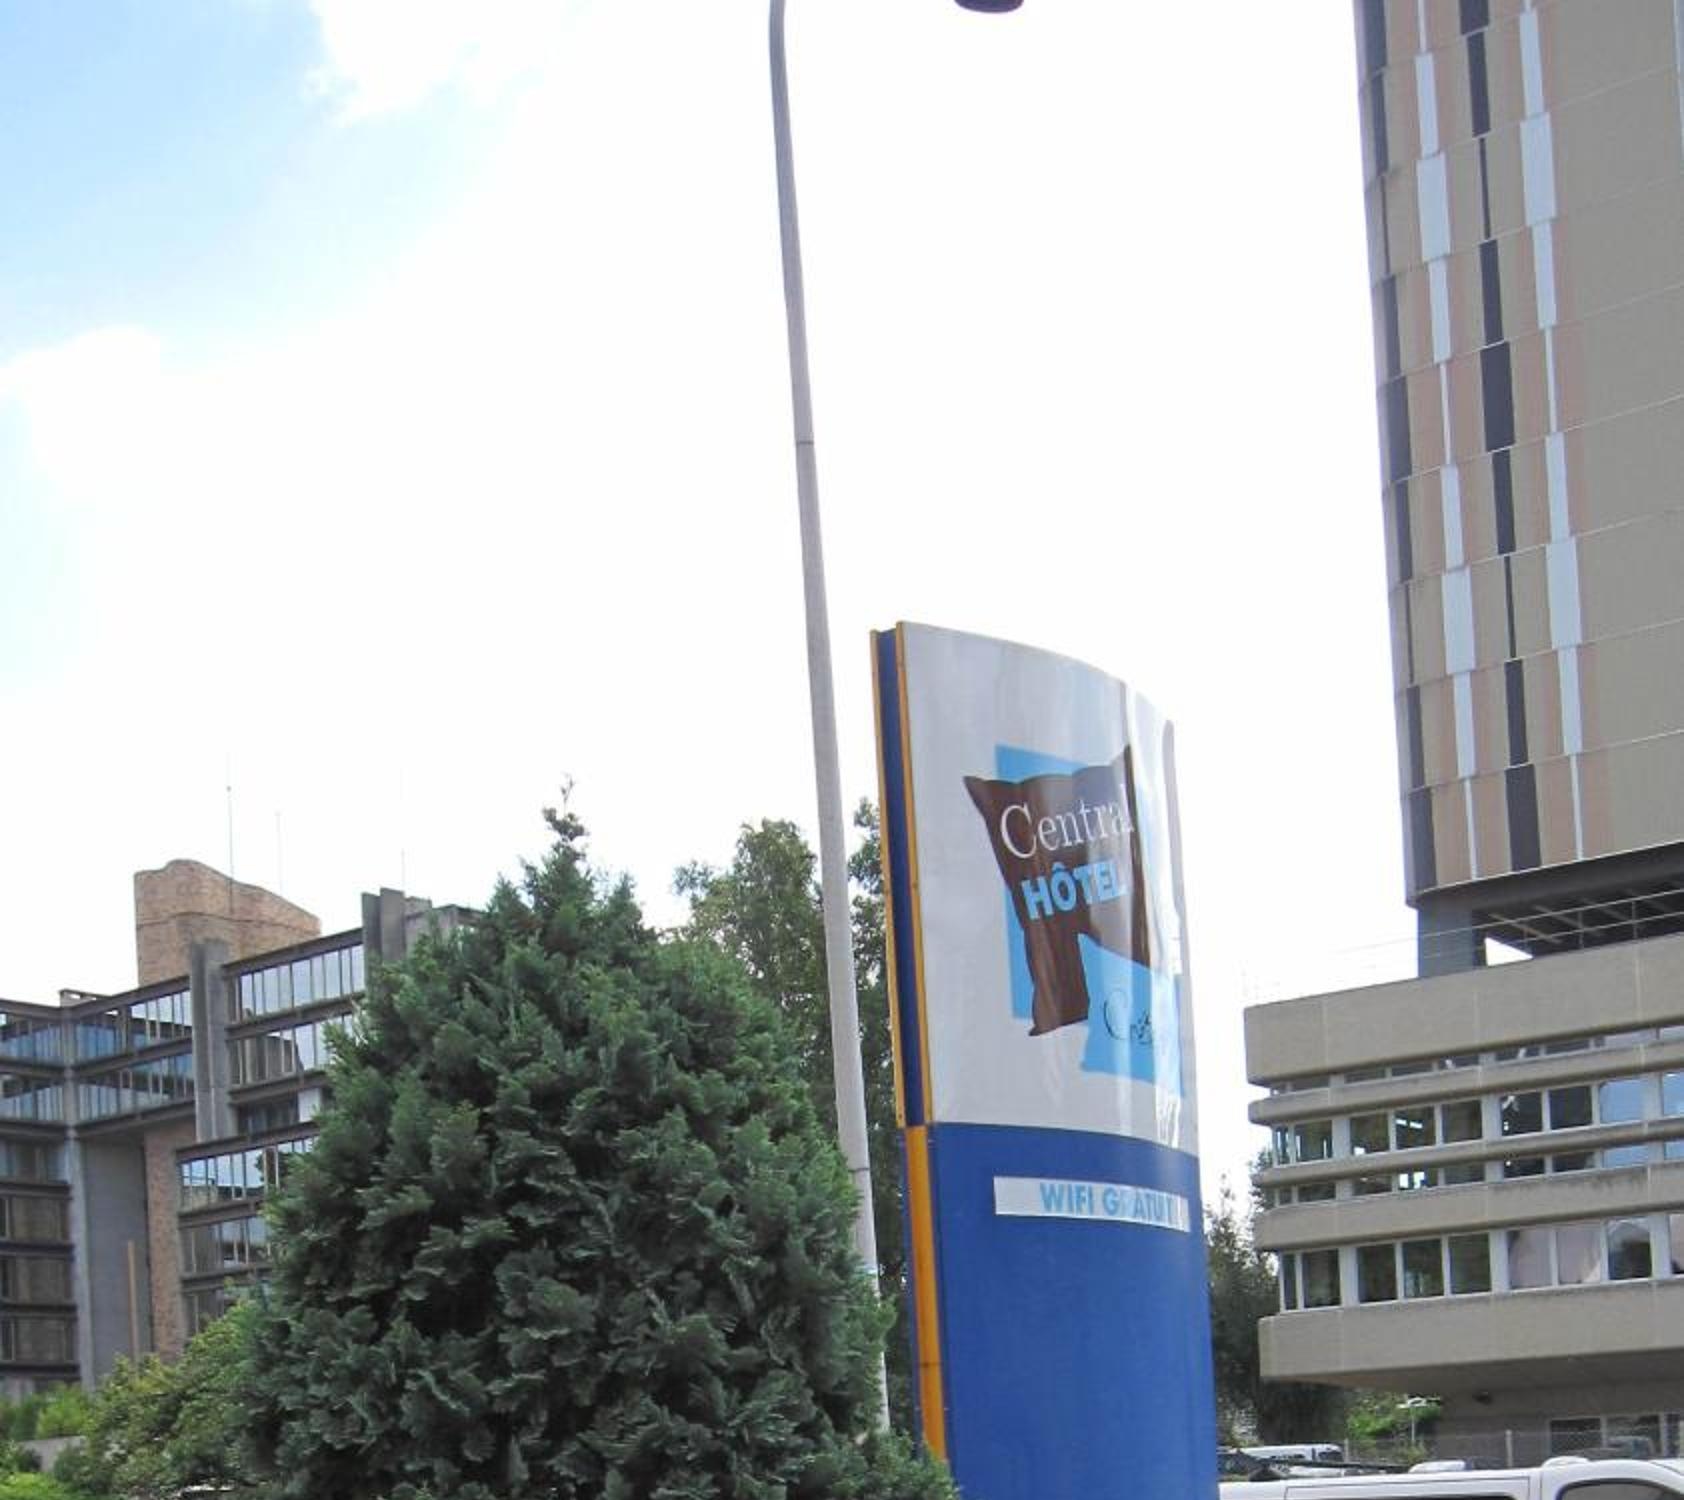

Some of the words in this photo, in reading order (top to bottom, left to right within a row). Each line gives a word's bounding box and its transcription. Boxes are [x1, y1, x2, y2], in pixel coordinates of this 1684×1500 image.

[1001, 783, 1134, 859] Central
[1021, 861, 1128, 920] HÔTEL
[1040, 1182, 1094, 1215] WIFI
